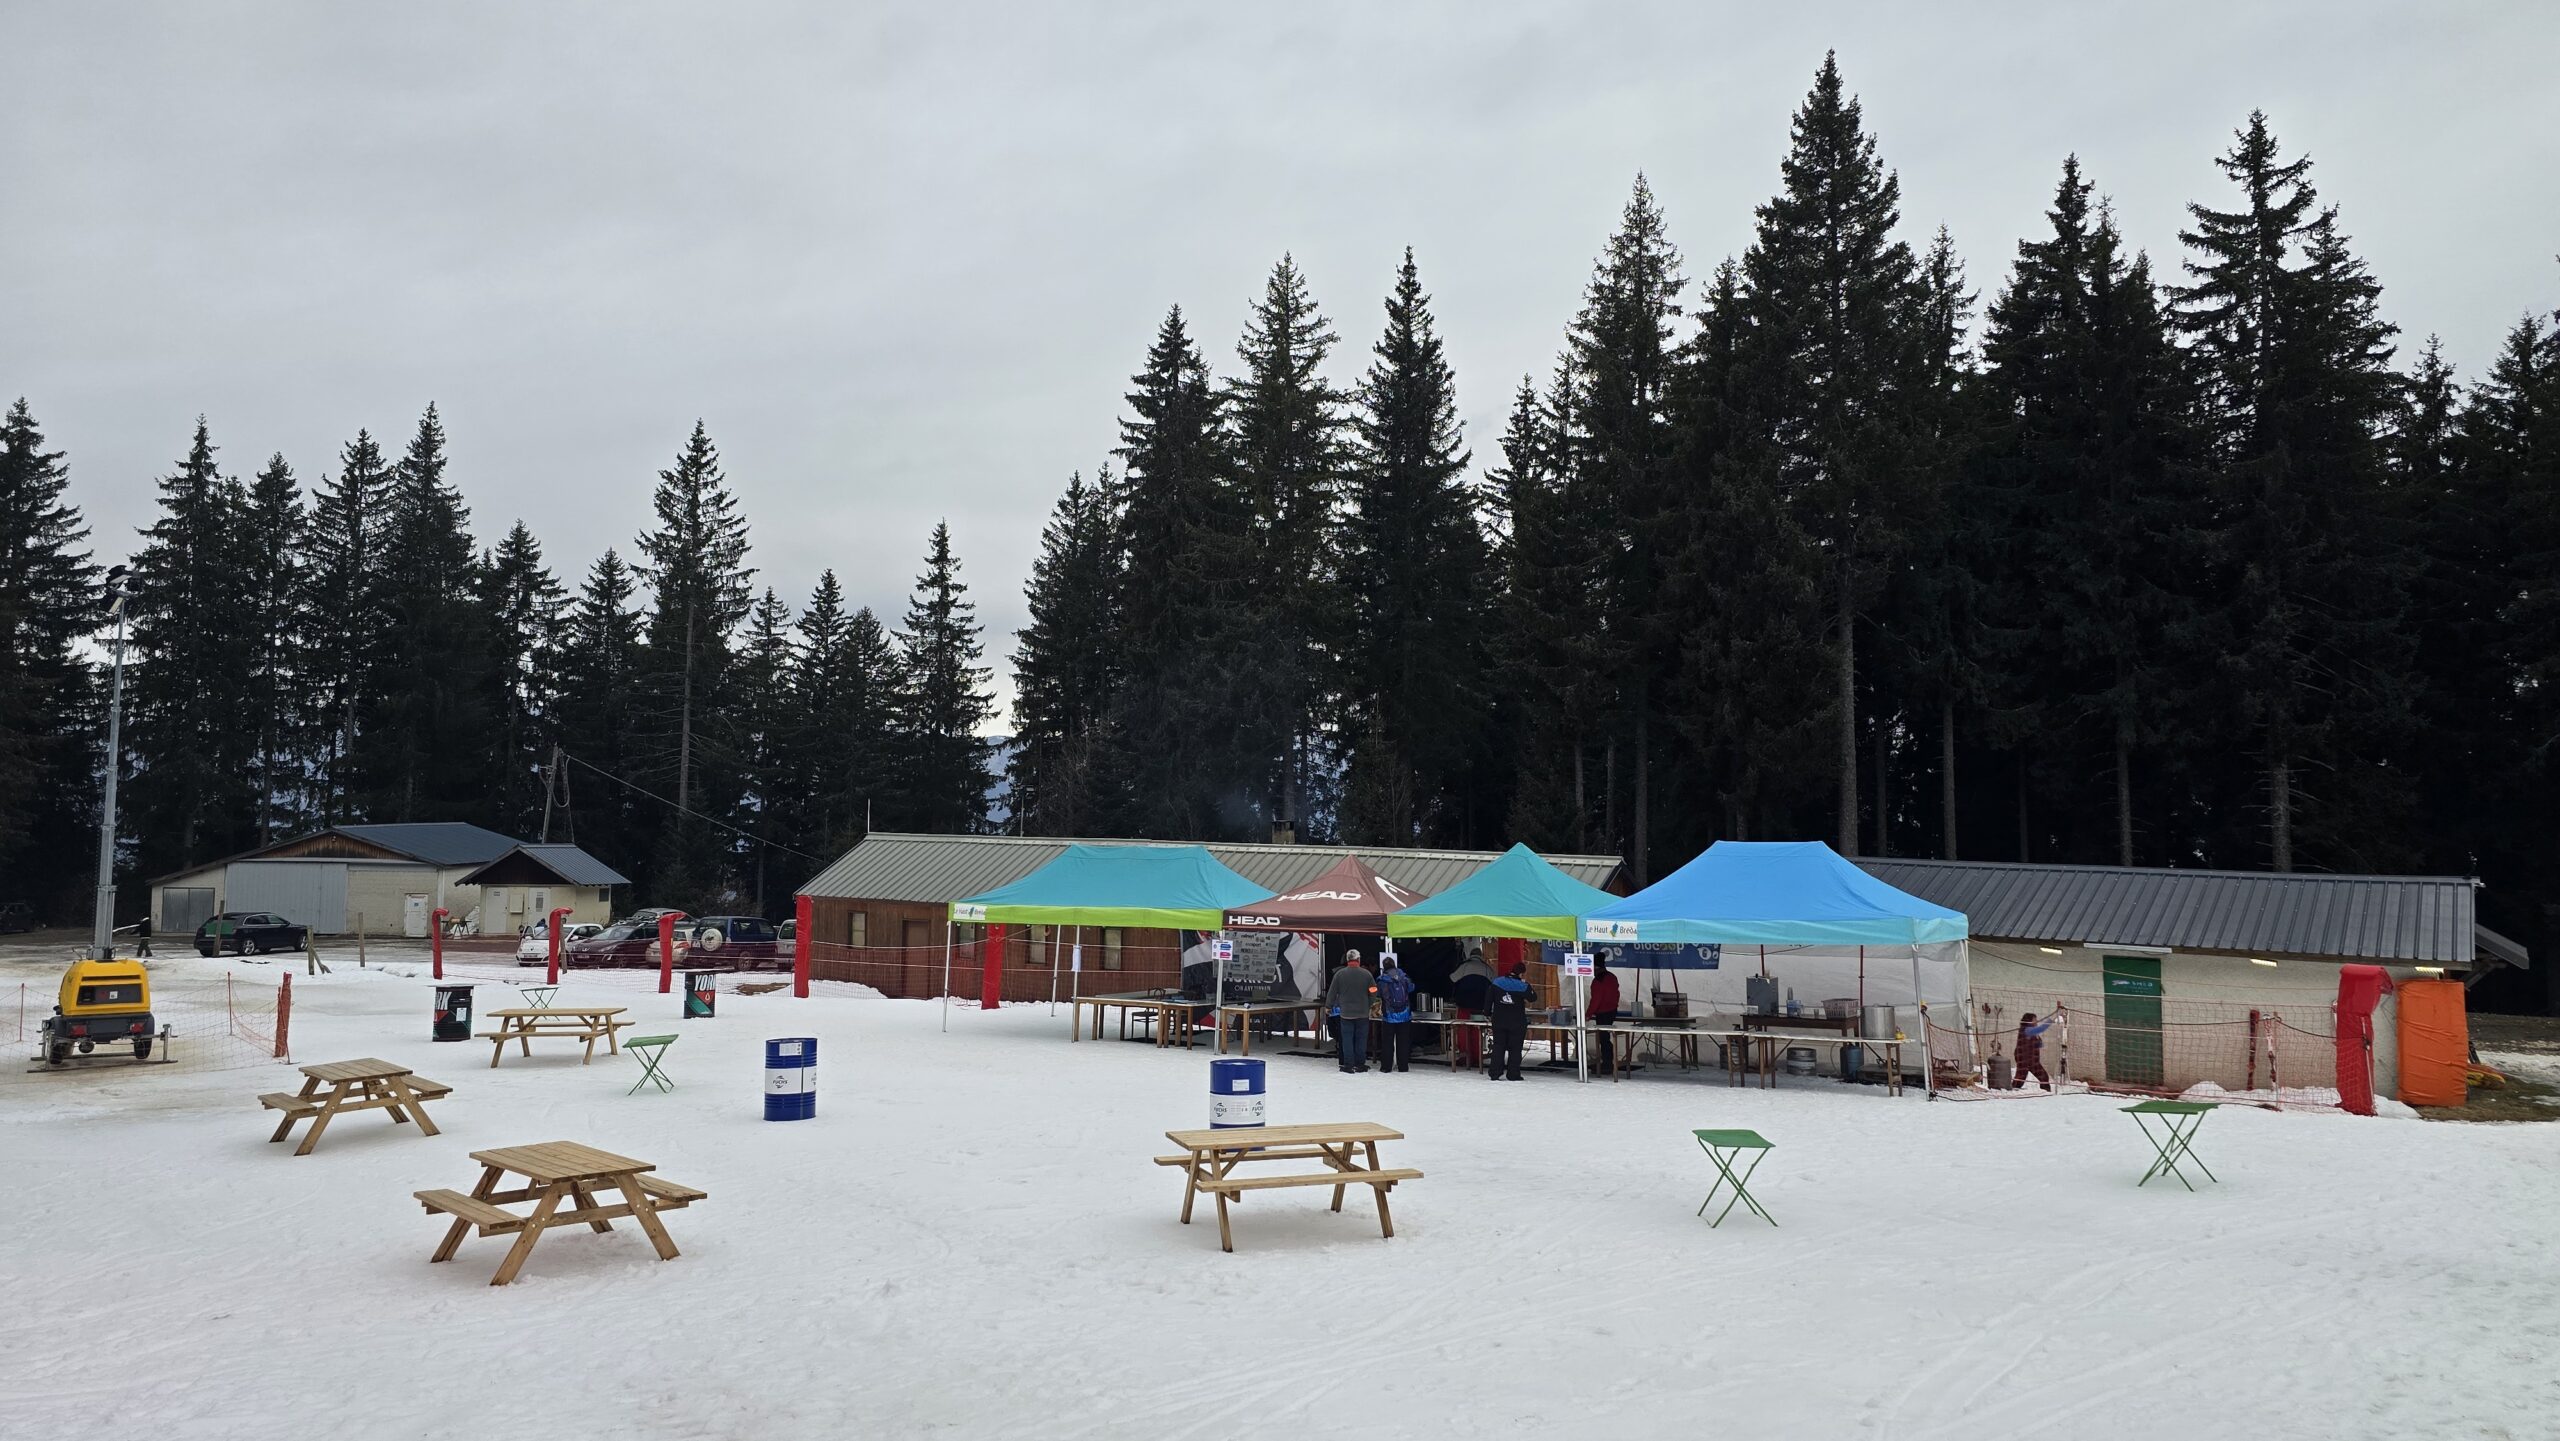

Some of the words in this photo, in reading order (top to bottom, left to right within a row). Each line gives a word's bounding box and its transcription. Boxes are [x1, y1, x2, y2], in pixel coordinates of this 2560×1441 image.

[1277, 891, 1362, 902] HEAD
[1228, 916, 1281, 926] HEAD
[1594, 925, 1608, 933] Haut
[695, 974, 716, 991] YOR
